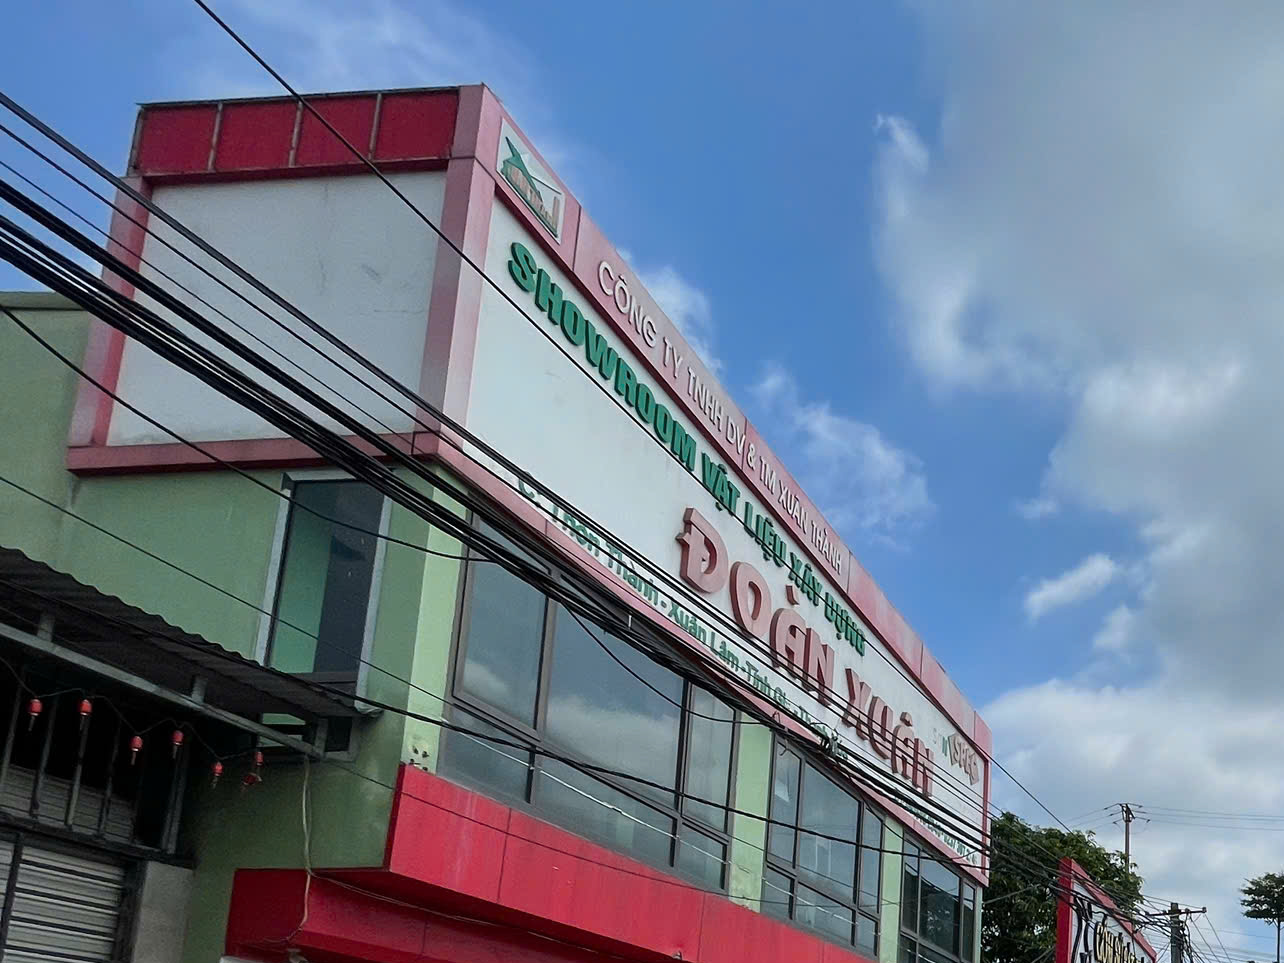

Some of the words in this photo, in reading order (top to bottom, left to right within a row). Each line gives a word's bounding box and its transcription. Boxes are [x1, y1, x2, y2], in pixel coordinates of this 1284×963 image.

[507, 242, 697, 472] SHOWROOM
[702, 452, 741, 517] VẬT
[744, 501, 787, 568] LIỆU
[788, 552, 823, 607] XÂY
[824, 592, 865, 657] DỰNG
[598, 260, 656, 348] CÔNG
[662, 336, 683, 379] TY
[687, 366, 723, 432] TNHH
[726, 416, 746, 454] DV
[747, 443, 756, 472] &
[760, 456, 777, 495] TM
[811, 519, 841, 575] THÀNH
[675, 507, 835, 707] ĐOÀN
[841, 667, 934, 799] XUÂN
